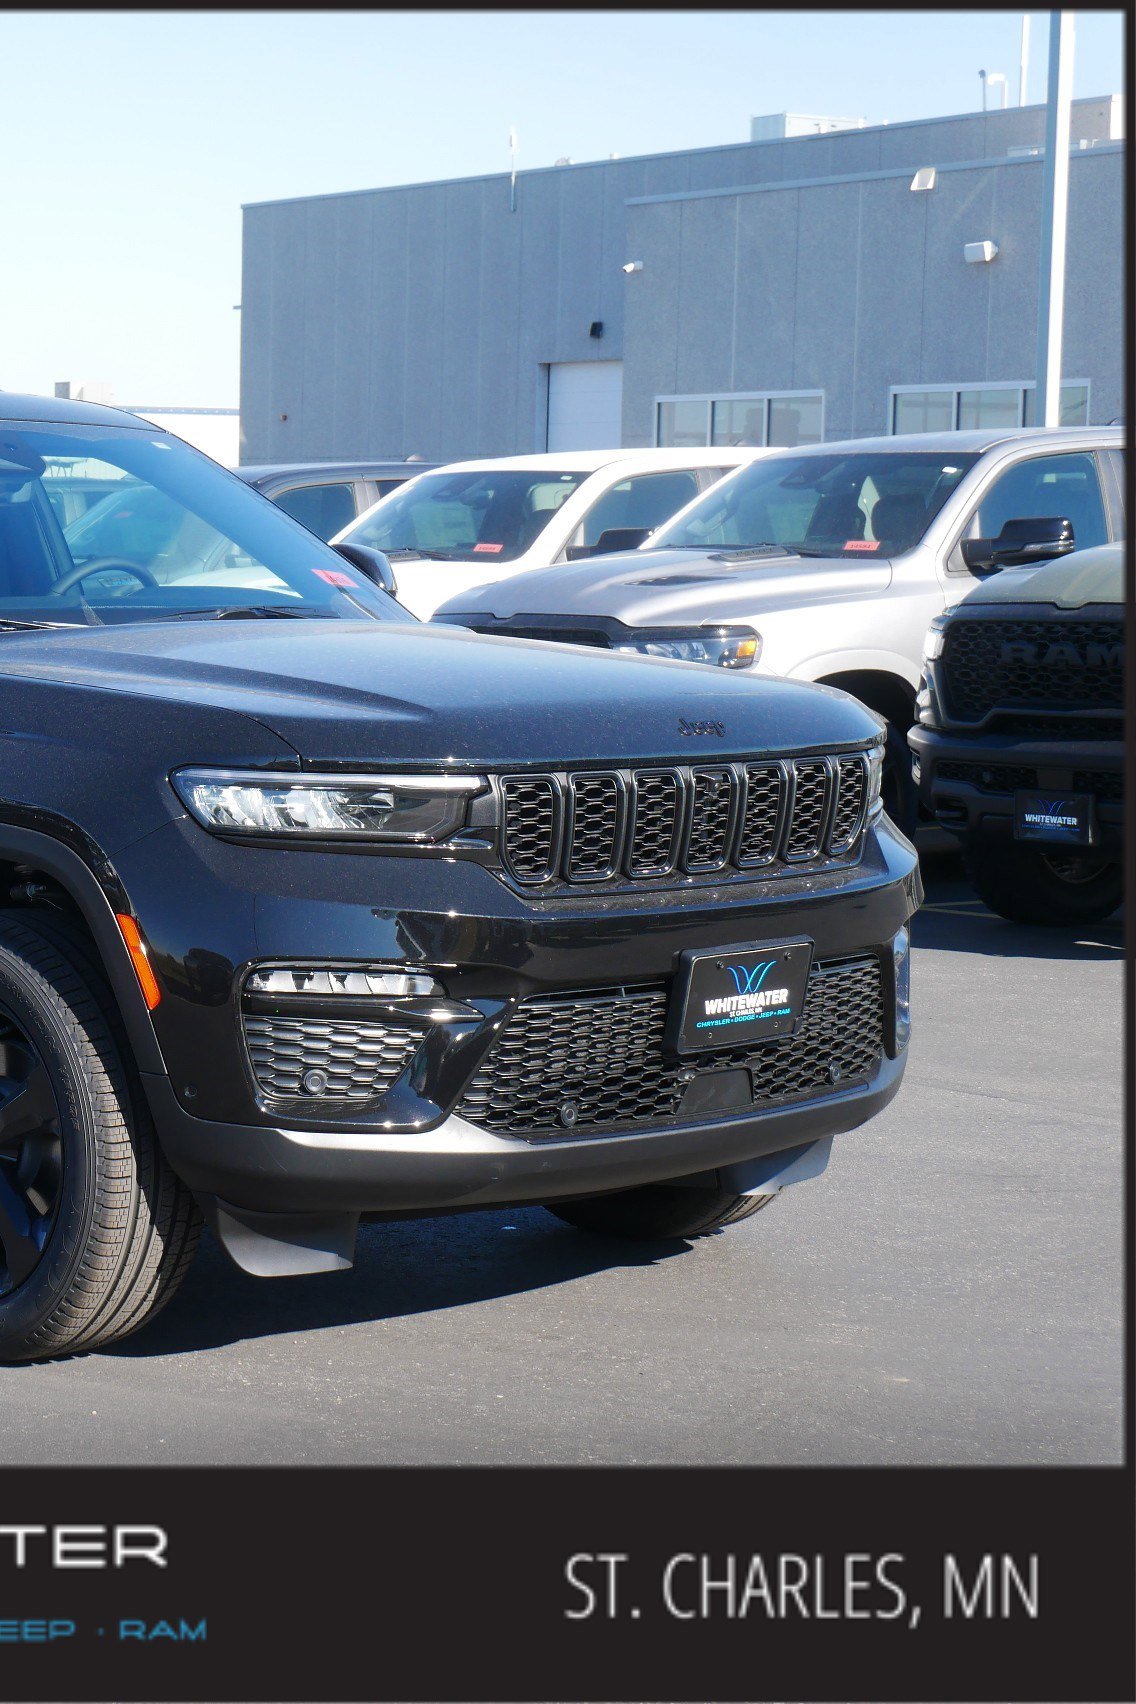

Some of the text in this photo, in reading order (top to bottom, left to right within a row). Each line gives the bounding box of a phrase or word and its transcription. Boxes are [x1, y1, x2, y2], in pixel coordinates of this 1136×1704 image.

[1000, 640, 1126, 666] RAM
[678, 718, 725, 738] Jeep
[1024, 813, 1078, 826] WHITEWATER
[704, 988, 789, 1015] WHITEWATER
[696, 1007, 791, 1028] CHRYSLER DODGE JEEP RAM
